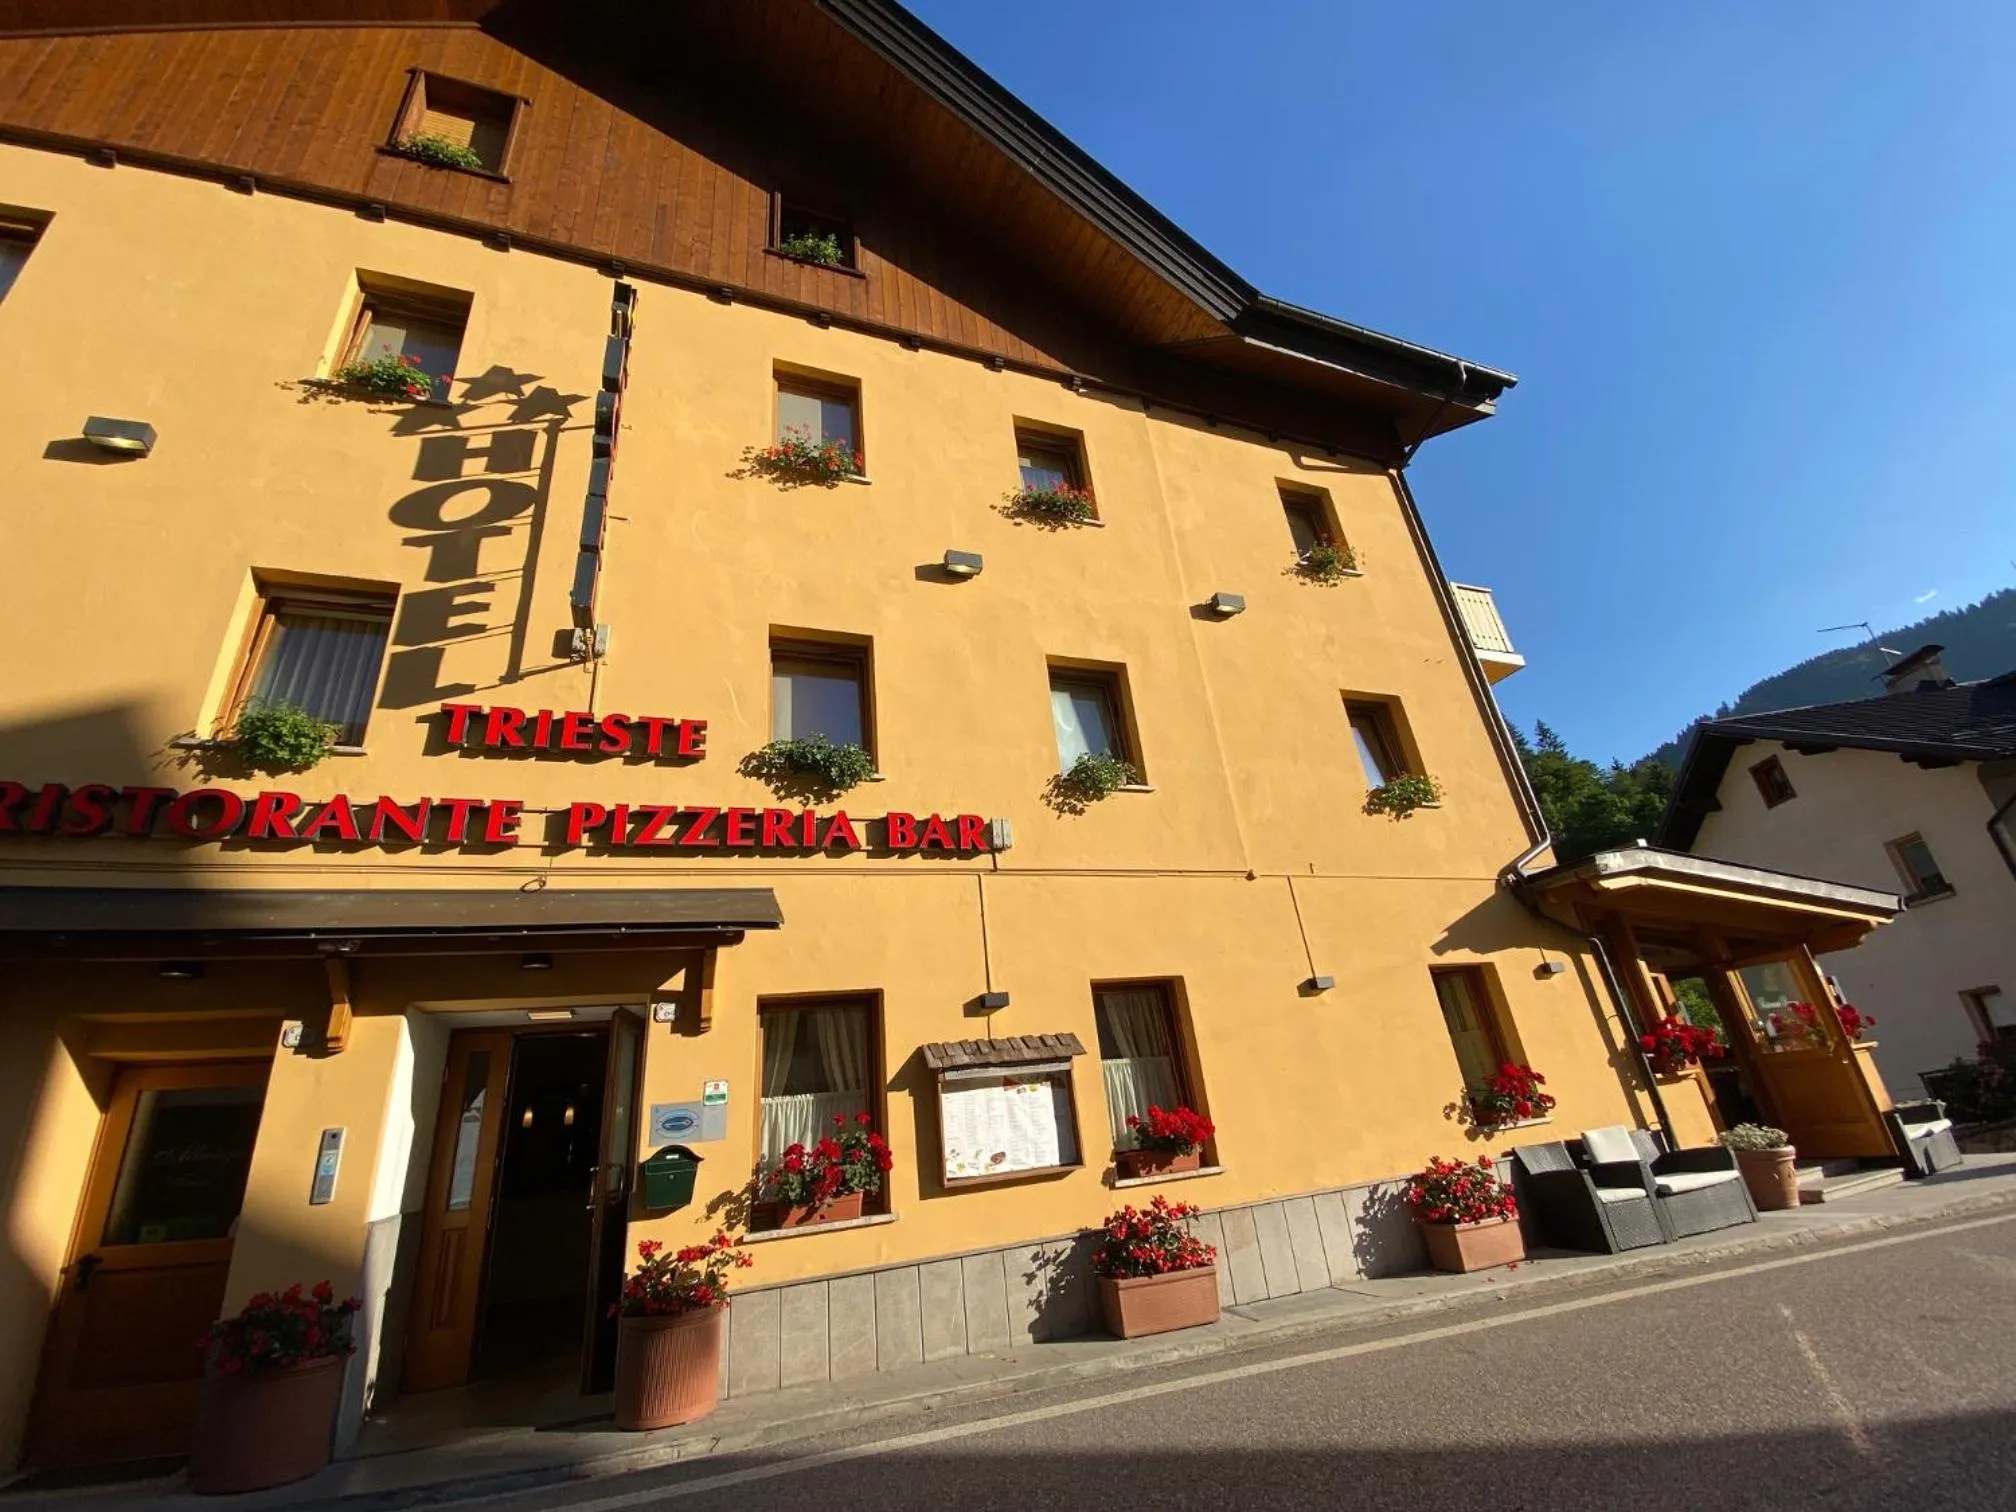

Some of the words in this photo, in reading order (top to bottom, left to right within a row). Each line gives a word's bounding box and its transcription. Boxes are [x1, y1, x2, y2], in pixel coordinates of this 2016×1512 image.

[378, 429, 537, 709] HOTEL
[441, 703, 707, 758] TRIESTE
[567, 801, 861, 850] PIZZERIA
[887, 812, 989, 851] BAR
